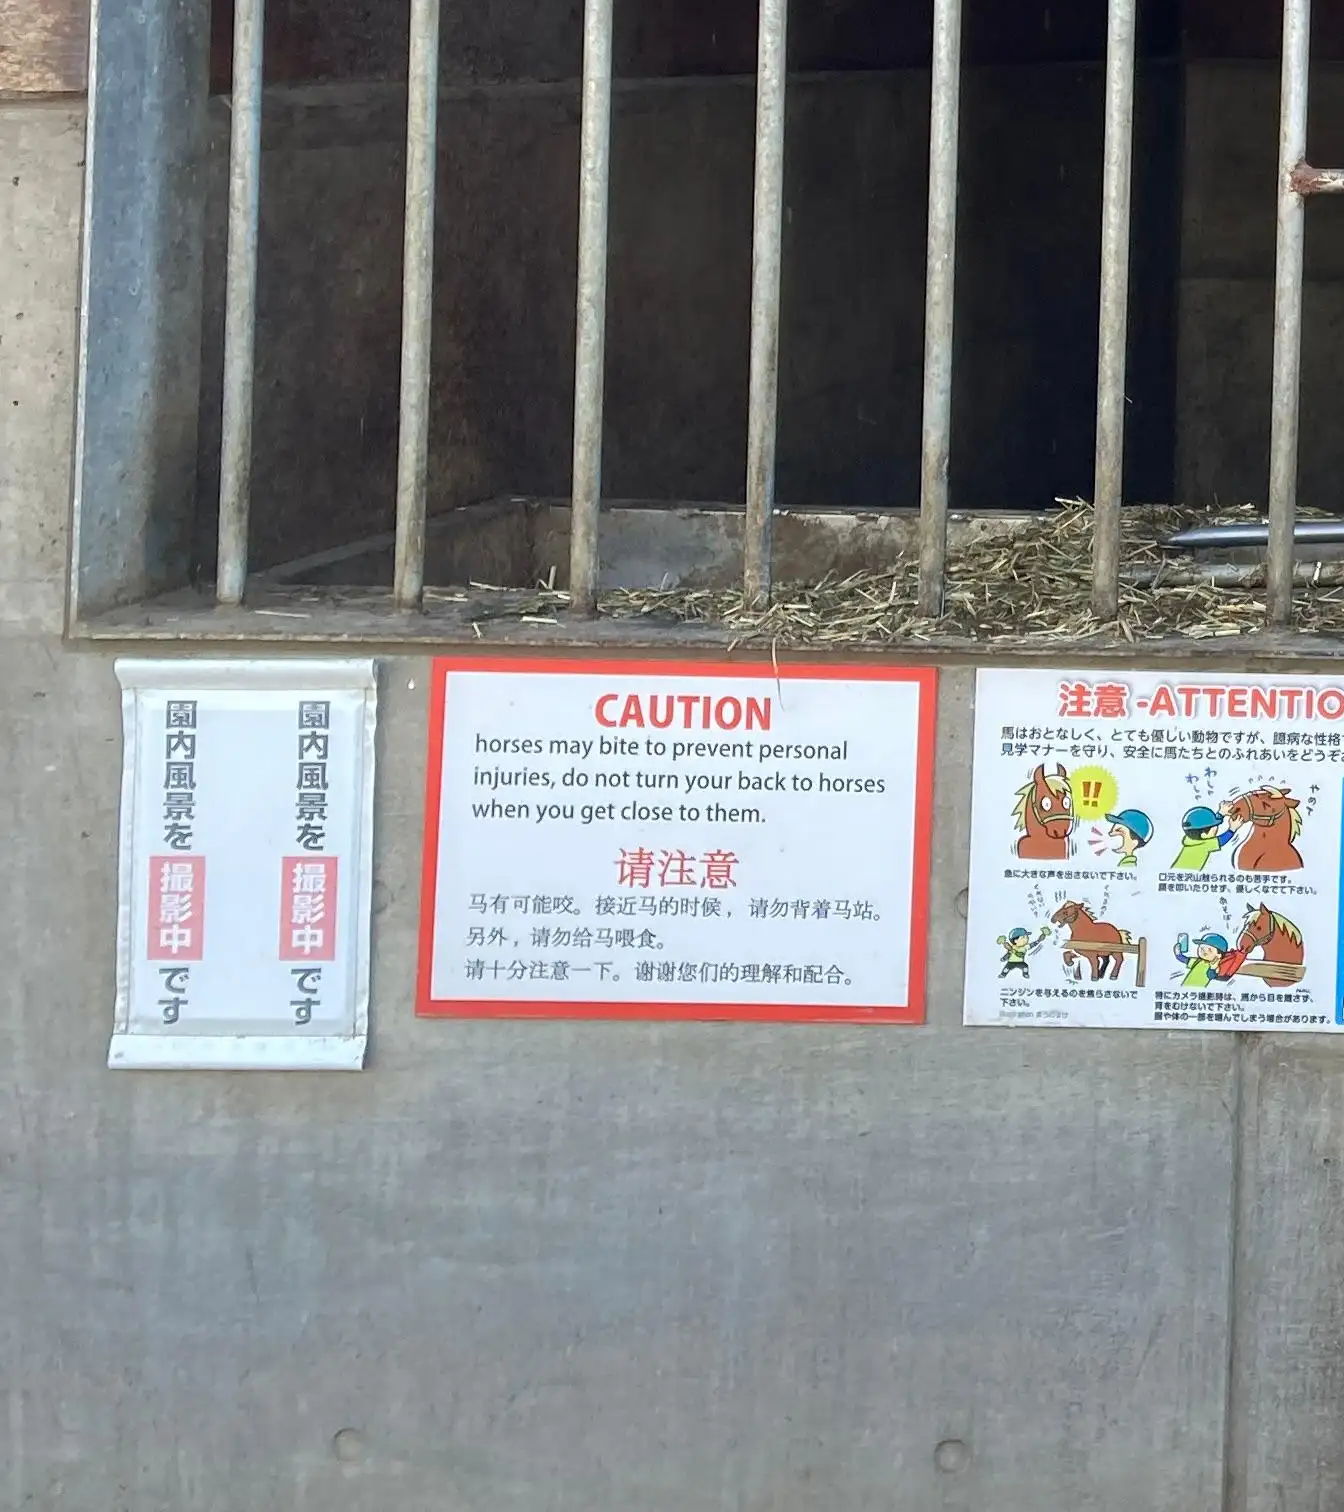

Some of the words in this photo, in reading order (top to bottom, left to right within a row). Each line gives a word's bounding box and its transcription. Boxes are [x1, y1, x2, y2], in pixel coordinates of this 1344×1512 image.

[594, 693, 771, 731] CAUTION
[1058, 683, 1128, 719] 注意
[475, 733, 543, 754] horses
[549, 739, 593, 759] may
[599, 736, 639, 756] bite
[645, 739, 666, 757] to
[673, 740, 753, 761] prevent
[759, 741, 847, 763] personal
[473, 767, 556, 791] injuries,
[562, 767, 588, 788] do
[594, 771, 630, 788] not
[635, 772, 679, 789] turn
[685, 775, 732, 794] your
[738, 772, 786, 792] back
[791, 775, 813, 792] to
[819, 773, 886, 794] horses
[472, 799, 529, 820] when
[536, 805, 574, 824] you
[580, 804, 615, 824] get
[620, 801, 673, 821] close
[679, 804, 699, 821] to
[706, 804, 766, 823] them.
[158, 700, 198, 1025] 園内風景を撮影中です
[290, 701, 331, 1026] 園内風景を撮影中です
[614, 847, 739, 889] 请注意
